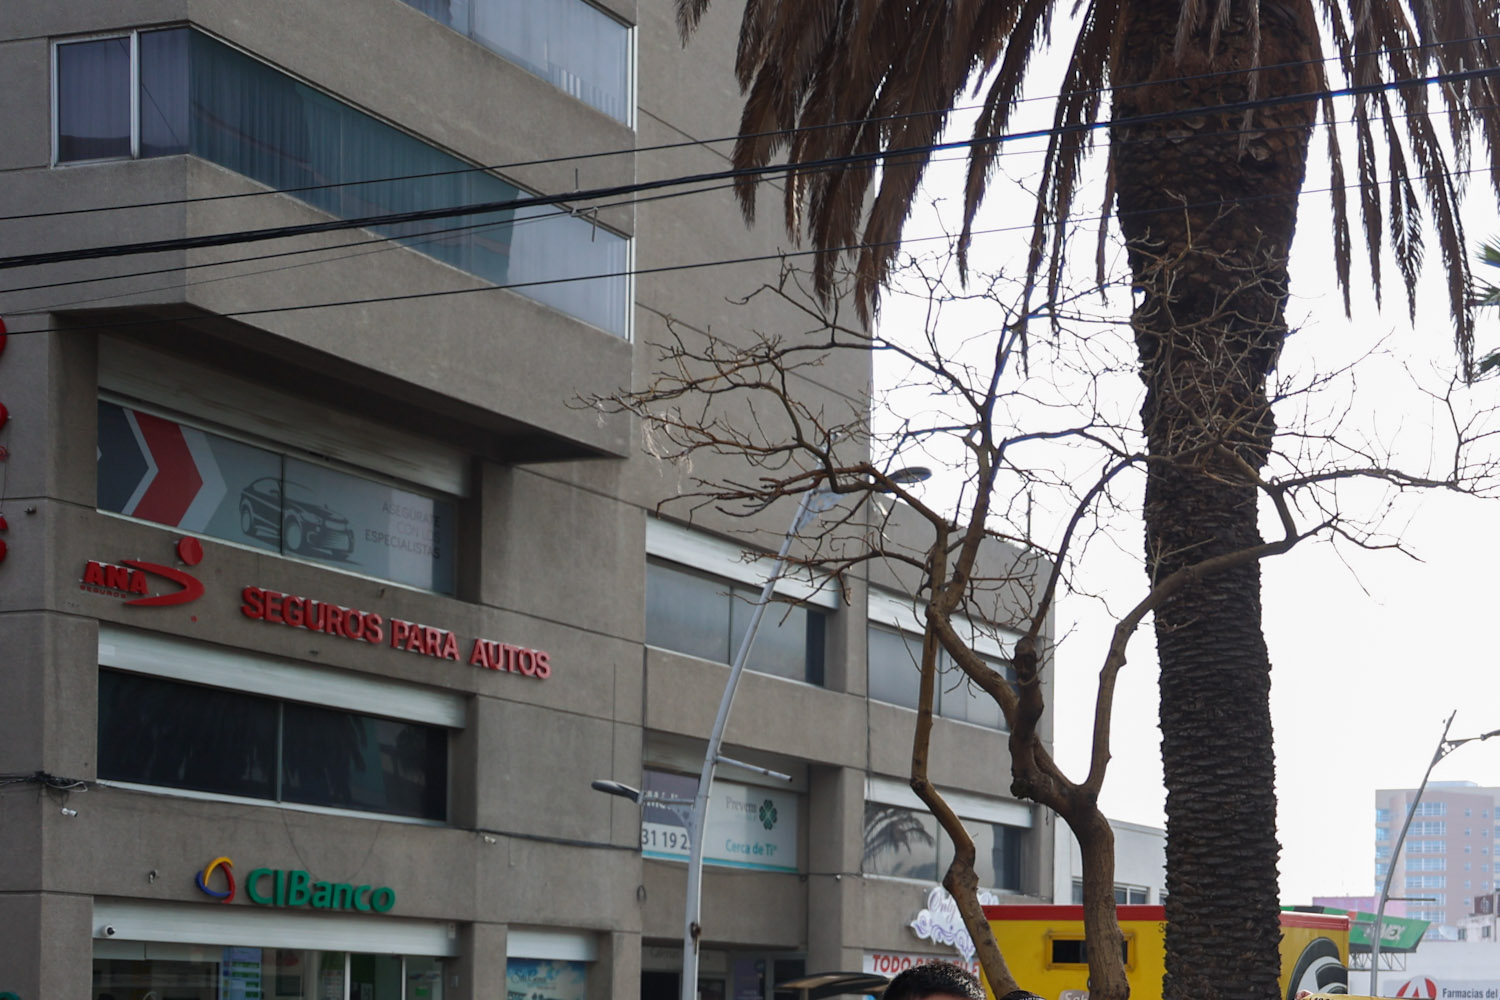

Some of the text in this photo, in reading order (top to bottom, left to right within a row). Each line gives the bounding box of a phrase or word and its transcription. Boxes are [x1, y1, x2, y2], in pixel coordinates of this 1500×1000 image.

[84, 561, 149, 595] ANA
[80, 584, 127, 599] SEGUROS
[241, 586, 551, 680] SEGUROS PARA AUTOS
[642, 828, 677, 848] 31 19
[725, 839, 764, 855] Cerca de
[244, 868, 396, 913] CIBanco
[873, 954, 911, 973] TODO
[1442, 987, 1484, 999] Farmacias
[1485, 988, 1498, 999] del
